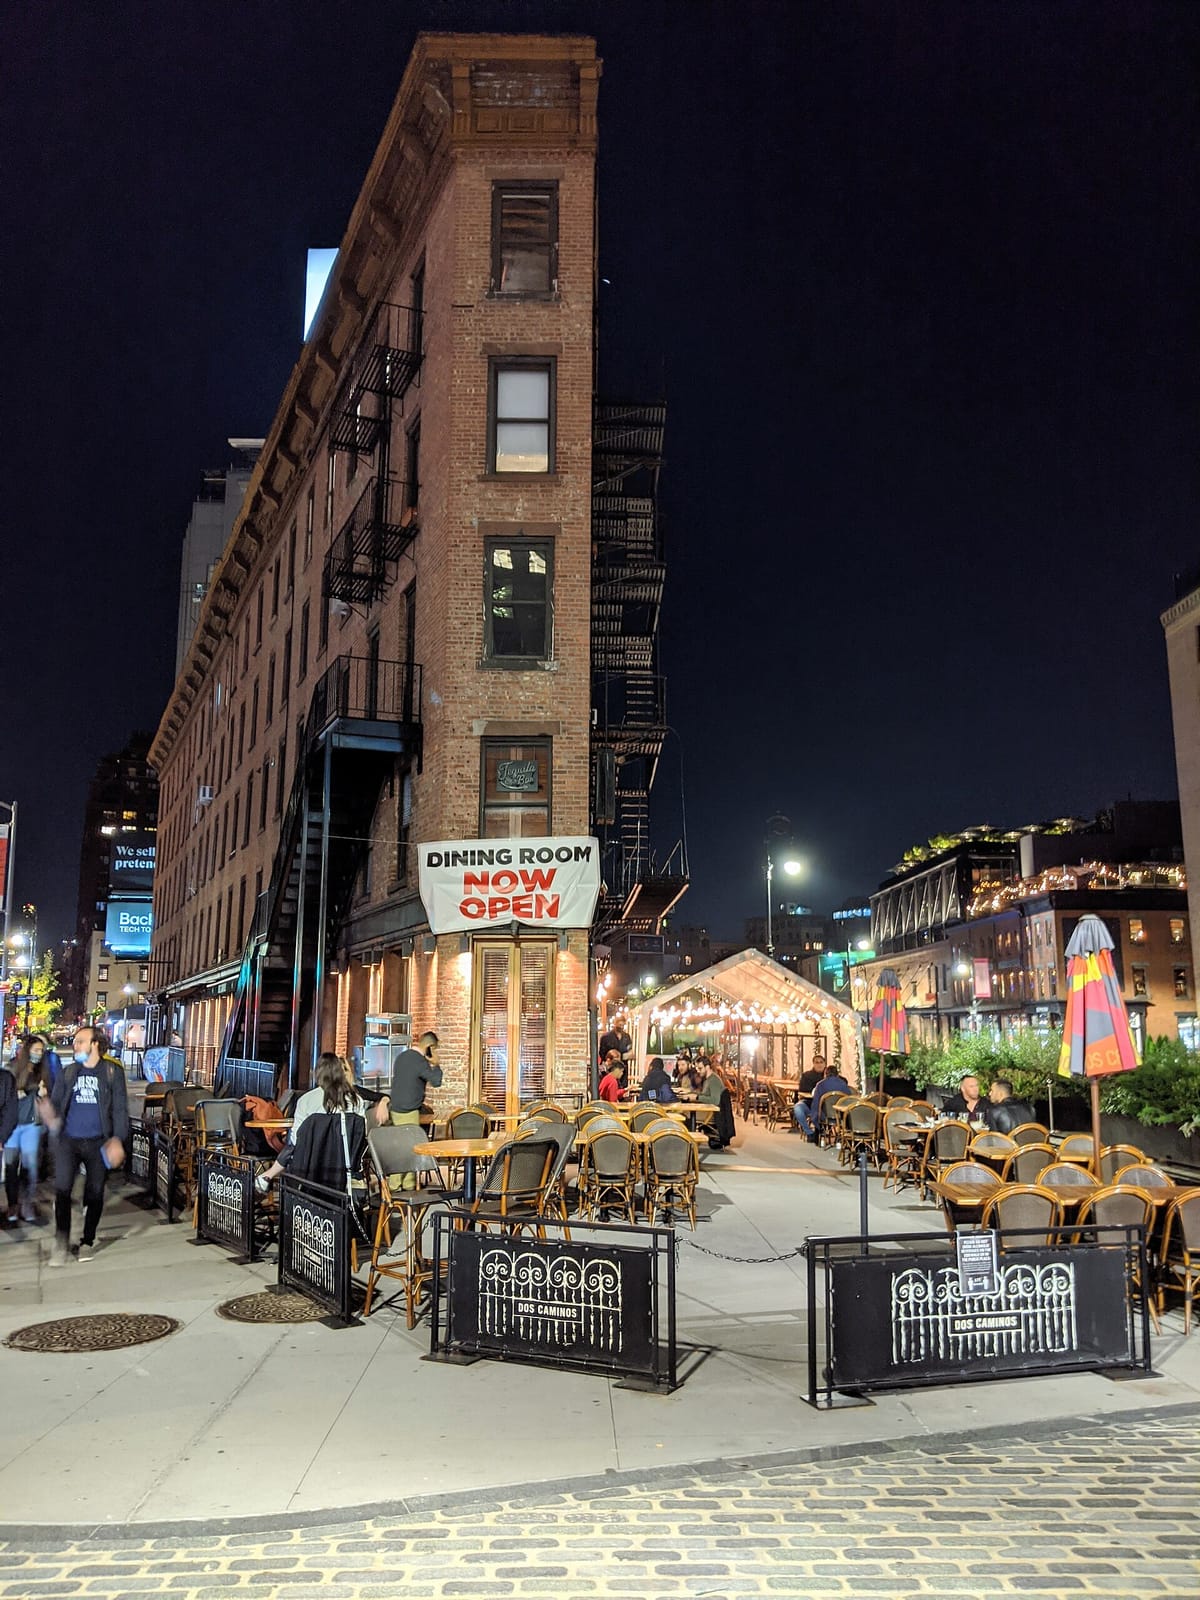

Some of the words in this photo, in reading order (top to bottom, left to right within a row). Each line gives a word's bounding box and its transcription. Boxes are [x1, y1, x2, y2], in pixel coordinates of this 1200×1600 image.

[116, 846, 134, 857] We
[136, 847, 156, 857] sell
[427, 848, 513, 868] DINING
[519, 846, 592, 865] ROOM
[115, 859, 156, 870] preten
[463, 868, 558, 895] NOW
[459, 894, 560, 920] OPEN
[518, 1302, 535, 1313] DOS
[537, 1304, 577, 1318] CAMINOS
[954, 1318, 973, 1330] DOS
[975, 1316, 1018, 1328] CAMINOS
